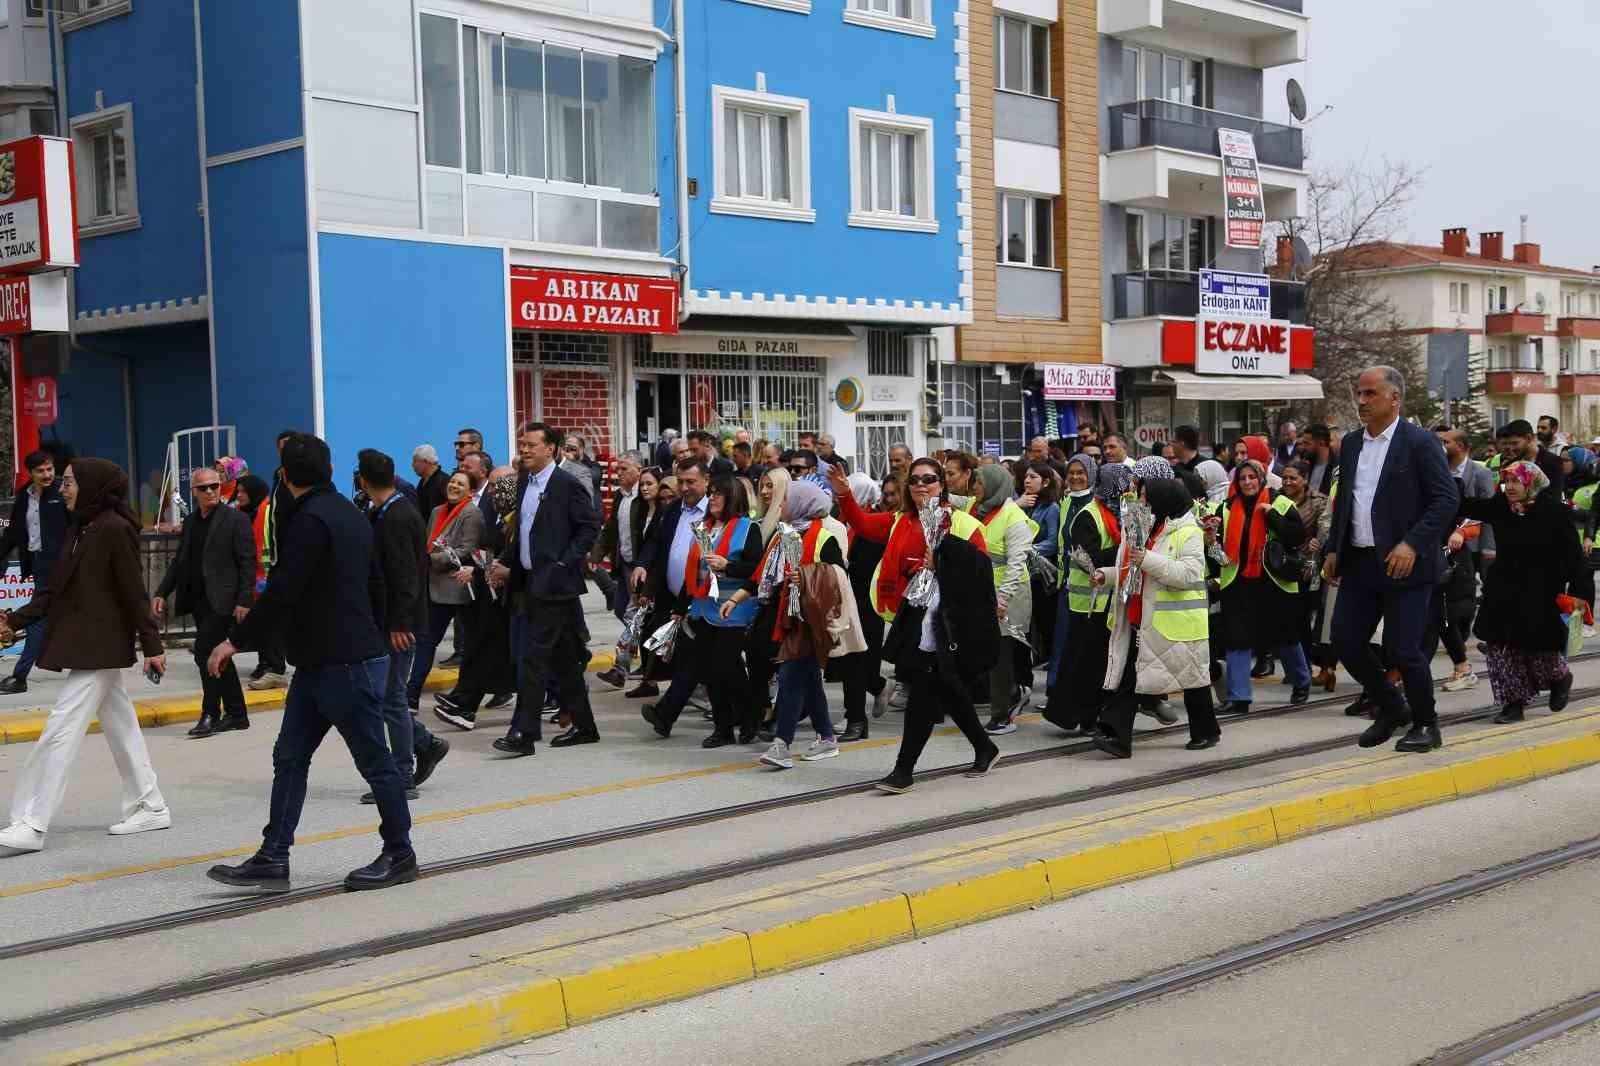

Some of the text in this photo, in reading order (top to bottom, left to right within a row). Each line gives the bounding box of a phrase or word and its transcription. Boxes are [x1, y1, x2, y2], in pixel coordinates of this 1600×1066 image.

[1227, 180, 1259, 195] KİRALIK
[1236, 197, 1255, 208] 3+1
[5, 240, 36, 257] TAVUK
[545, 278, 640, 302] ARIKAN
[1201, 293, 1267, 312] Erdoğan KANT
[520, 301, 660, 327] GIDA PAZARI
[718, 338, 799, 353] GIDA PAZARI
[1204, 320, 1287, 354] ECZANE
[1231, 355, 1260, 370] ONAT
[1047, 367, 1112, 386] Mia Butik
[1140, 428, 1168, 442] ONAT
